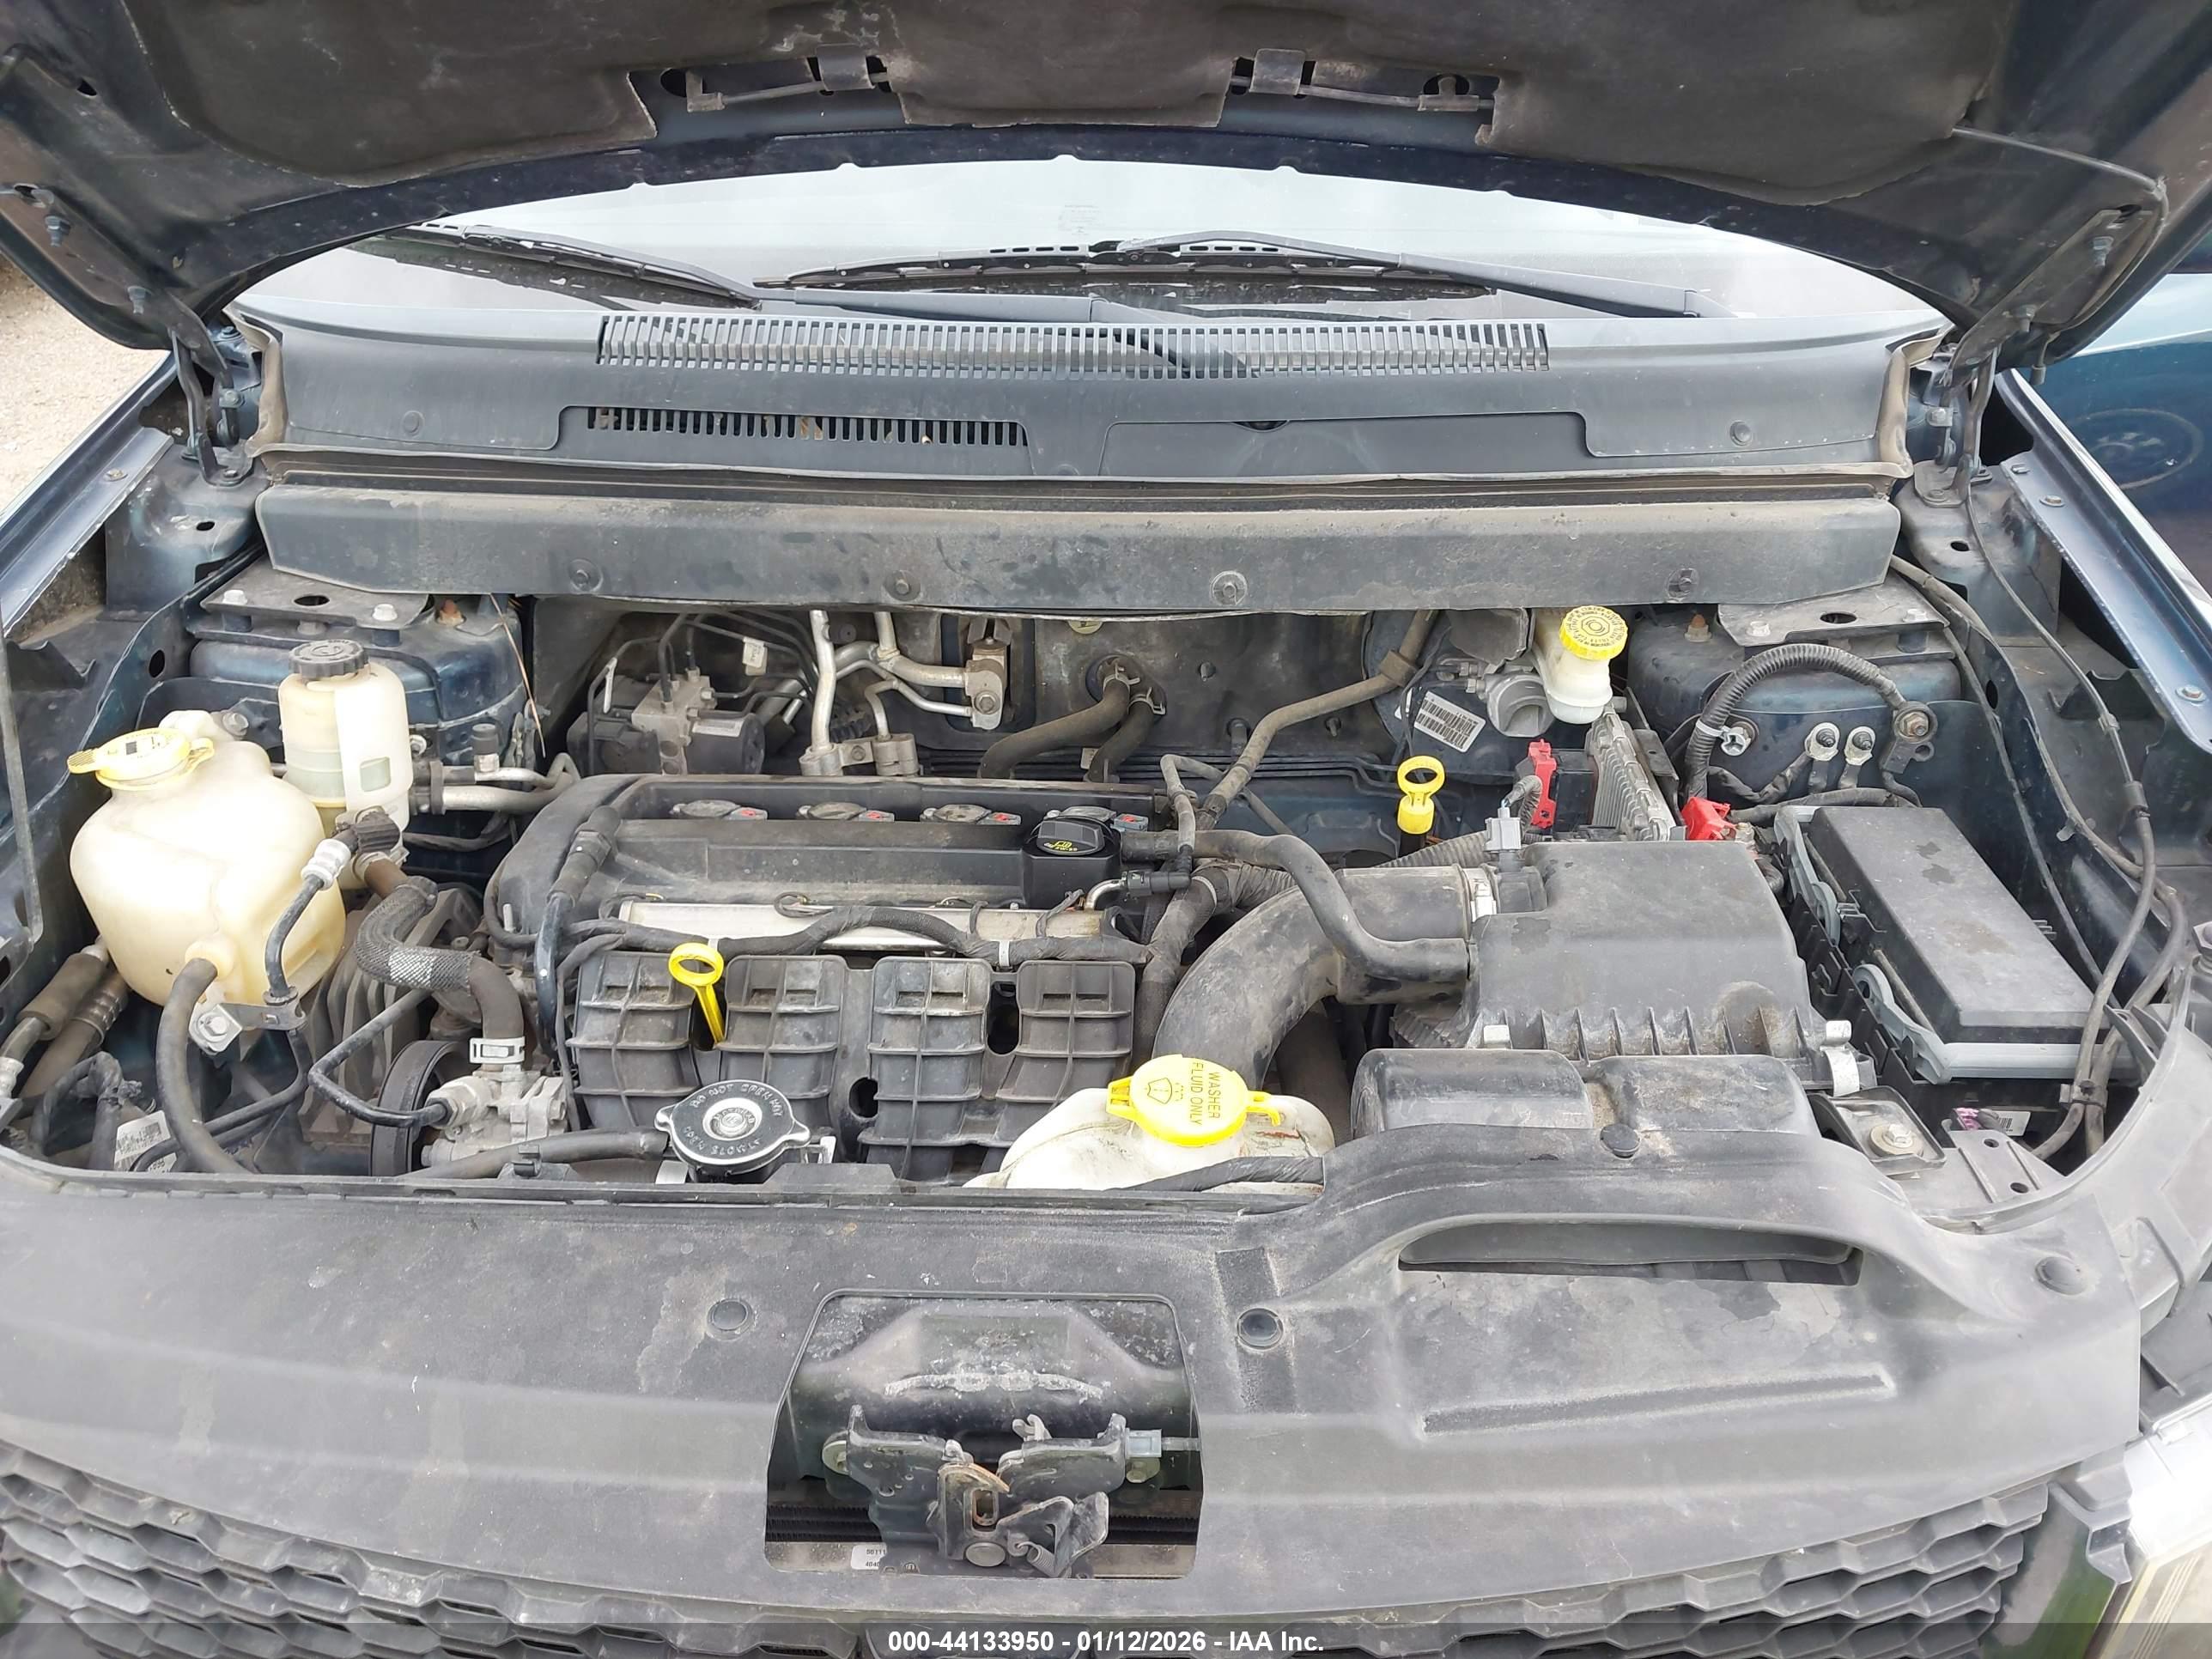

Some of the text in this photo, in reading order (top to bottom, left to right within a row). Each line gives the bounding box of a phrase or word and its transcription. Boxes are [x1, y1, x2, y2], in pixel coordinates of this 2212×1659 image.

[690, 1084, 783, 1117] DO NOT OPEN HOT
[1190, 1062, 1204, 1125] FLUID ONLY
[1208, 1072, 1221, 1118] WASHER
[684, 1126, 761, 1155] OPEN SLOWLY
